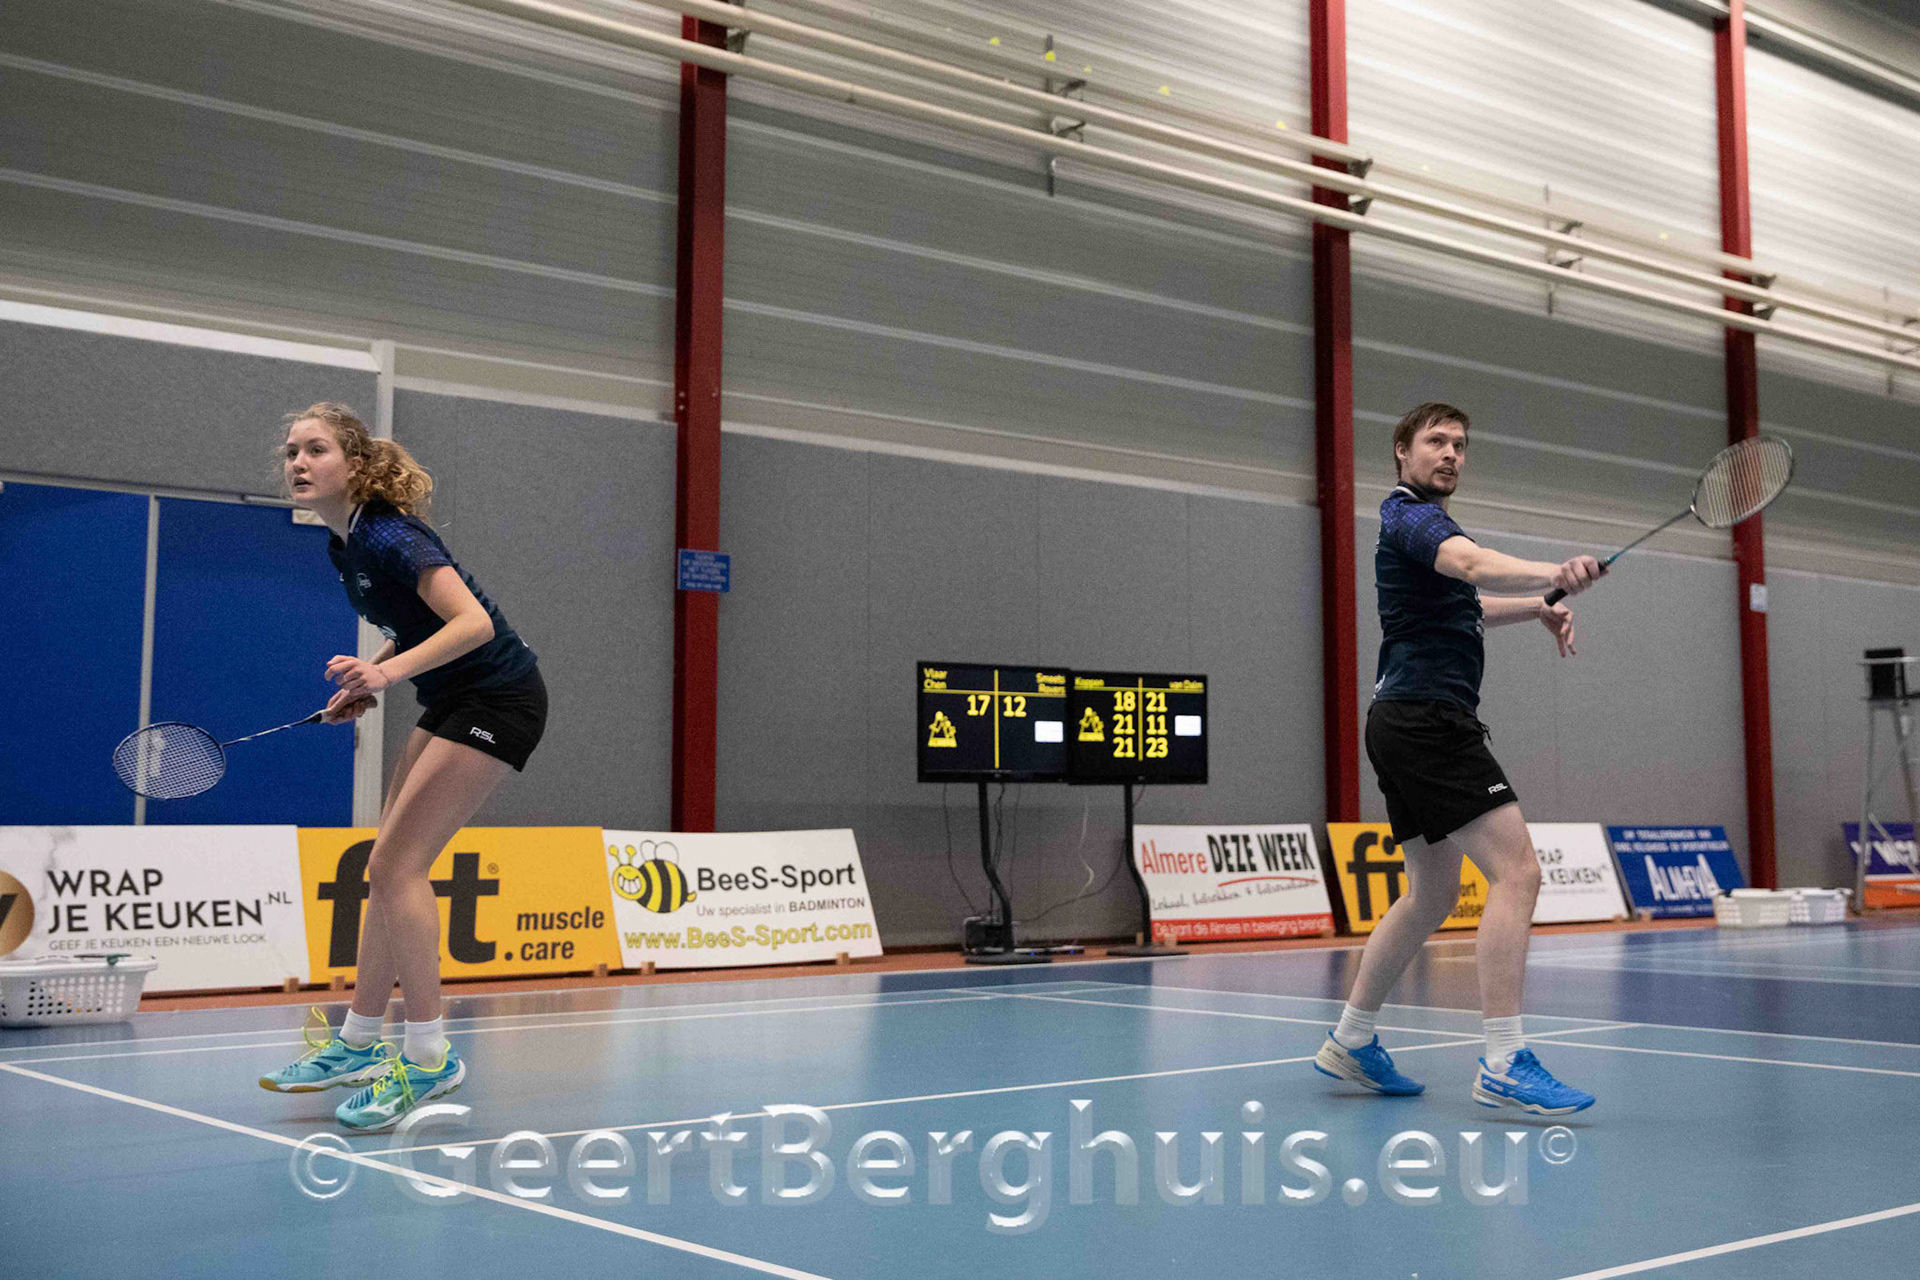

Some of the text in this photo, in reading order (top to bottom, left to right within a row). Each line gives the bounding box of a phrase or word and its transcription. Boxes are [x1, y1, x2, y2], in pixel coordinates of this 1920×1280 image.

[967, 694, 991, 716] 17
[1003, 695, 1027, 717] 12
[1113, 691, 1136, 712] 18
[1145, 691, 1168, 712] 21
[470, 726, 496, 744] RSL
[1112, 714, 1136, 735] 21
[1146, 714, 1168, 735] 11
[1113, 737, 1136, 758] 21
[1145, 737, 1169, 758] 23
[1488, 782, 1508, 795] RSL
[1141, 832, 1316, 874] Almere DEZE WEEK
[47, 869, 164, 898] WRAP
[697, 863, 856, 893] BeeS-Sport
[317, 839, 500, 968] ft
[696, 897, 866, 918] Uw specialist in BADMINTON
[48, 904, 90, 934] JE
[516, 906, 605, 931] muscle
[49, 933, 266, 951] GEEF JE KEUKEN EEN NIEUWE LOOK
[624, 922, 873, 950] www.BeeS-Sport.com
